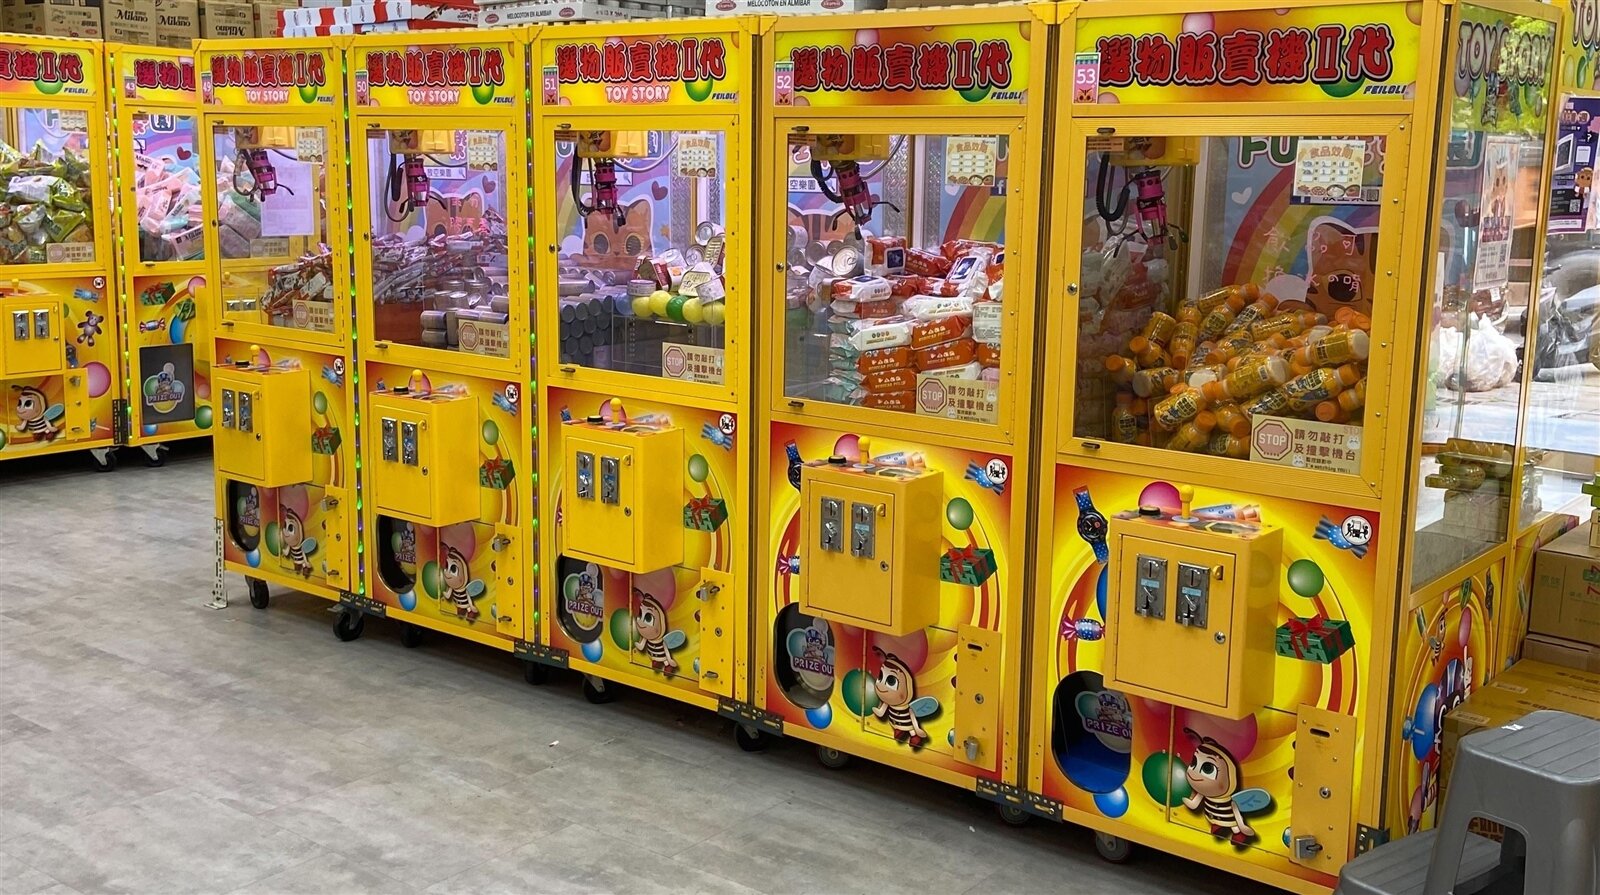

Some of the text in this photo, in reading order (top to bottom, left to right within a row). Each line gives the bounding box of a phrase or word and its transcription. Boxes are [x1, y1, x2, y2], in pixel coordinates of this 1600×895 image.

[116, 9, 148, 23] Milano
[159, 15, 191, 27] Milano
[1458, 20, 1498, 80] TOY
[776, 75, 791, 88] 52
[1076, 68, 1095, 84] 53
[125, 83, 135, 91] 43
[203, 81, 211, 92] 49
[356, 81, 367, 93] 50
[544, 77, 556, 90] 51
[1363, 84, 1408, 95] FEILOLI
[246, 90, 290, 102] TOY STORY
[408, 90, 460, 102] TOY STORY
[605, 86, 670, 101] TOY STORY
[712, 92, 736, 100] FEILOLI
[990, 92, 1023, 101] FEILOLI
[666, 356, 683, 367] STOP
[922, 390, 943, 401] STOP
[948, 385, 985, 399] 請勿敲打
[948, 397, 994, 412] 及撞擊機台
[1259, 433, 1287, 446] STOP
[1294, 428, 1345, 445] 請勿敲打
[1293, 443, 1356, 461] 及撞擊機台
[569, 600, 603, 617] PRIZE OUT
[794, 657, 834, 675] PRIZE OU
[1087, 719, 1120, 735] PRIZE
